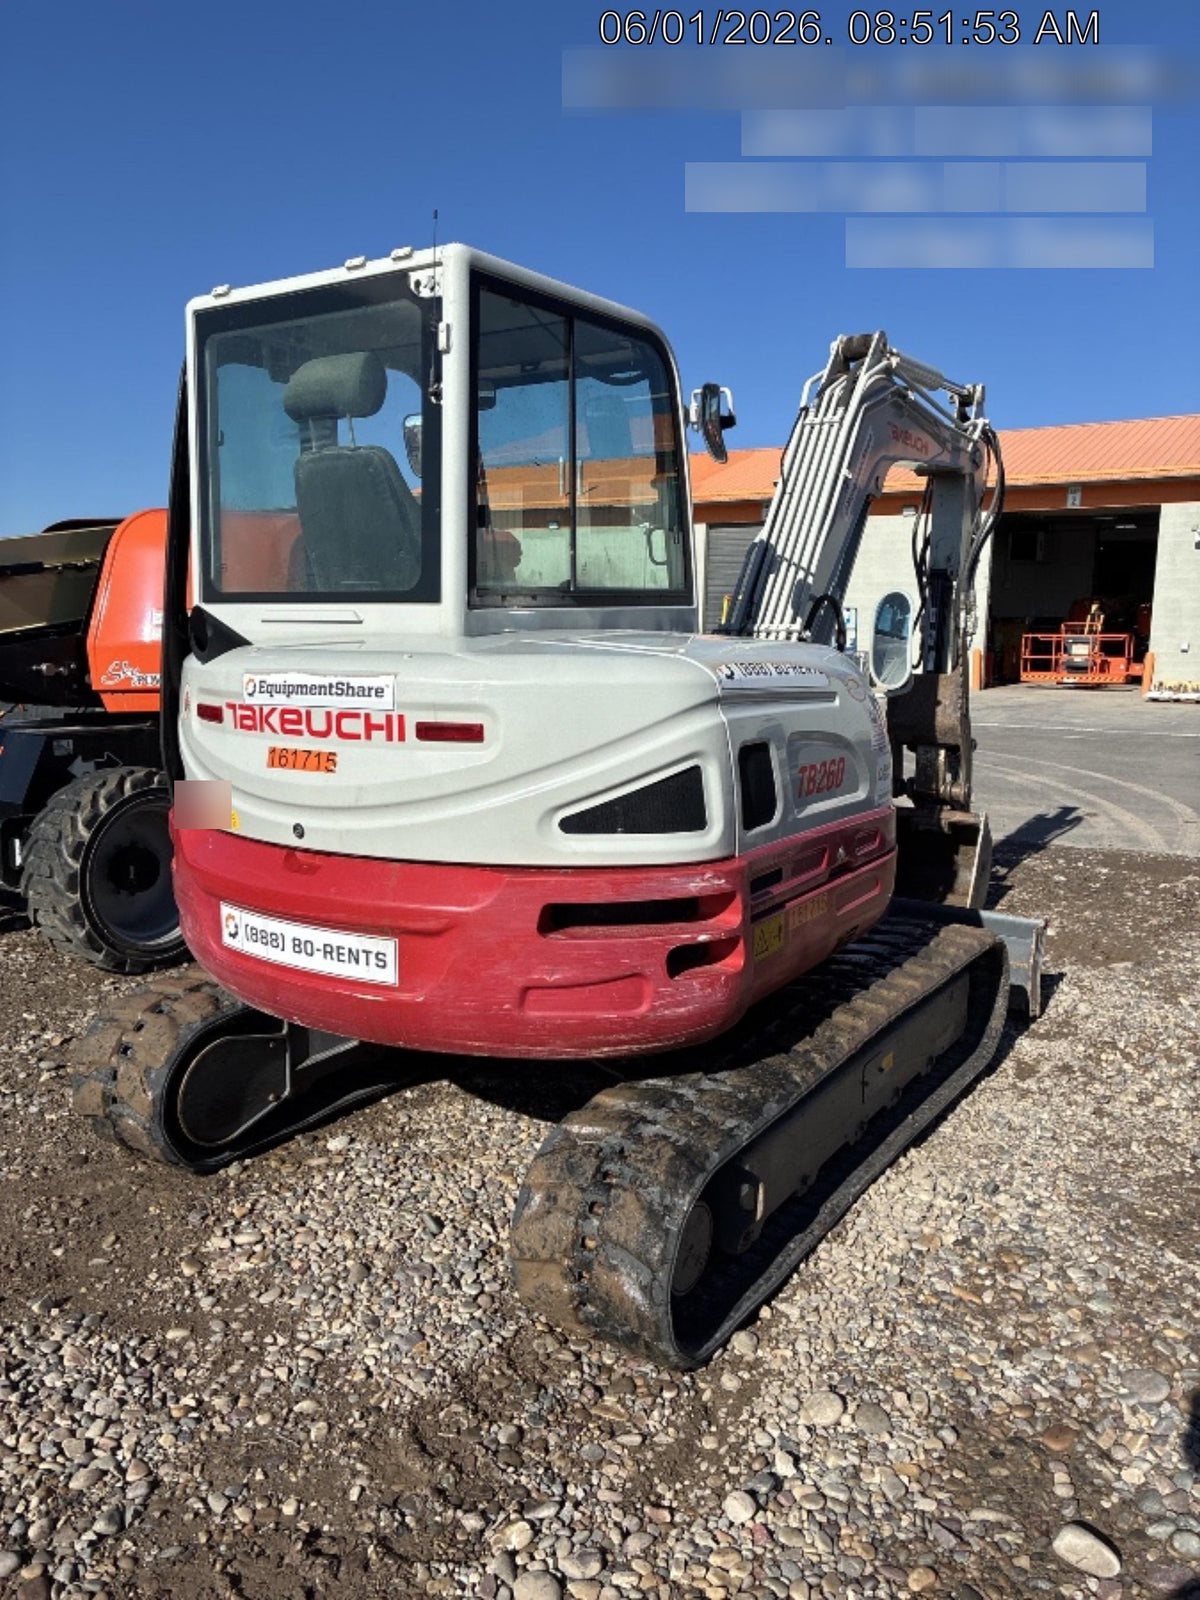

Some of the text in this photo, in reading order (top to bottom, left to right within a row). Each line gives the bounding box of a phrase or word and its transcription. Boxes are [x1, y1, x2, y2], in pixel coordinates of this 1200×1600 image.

[257, 679, 386, 699] EquipmentShare
[268, 747, 338, 774] 161715
[797, 756, 846, 799] TB260
[244, 922, 388, 970] (888) 80-RENTS
